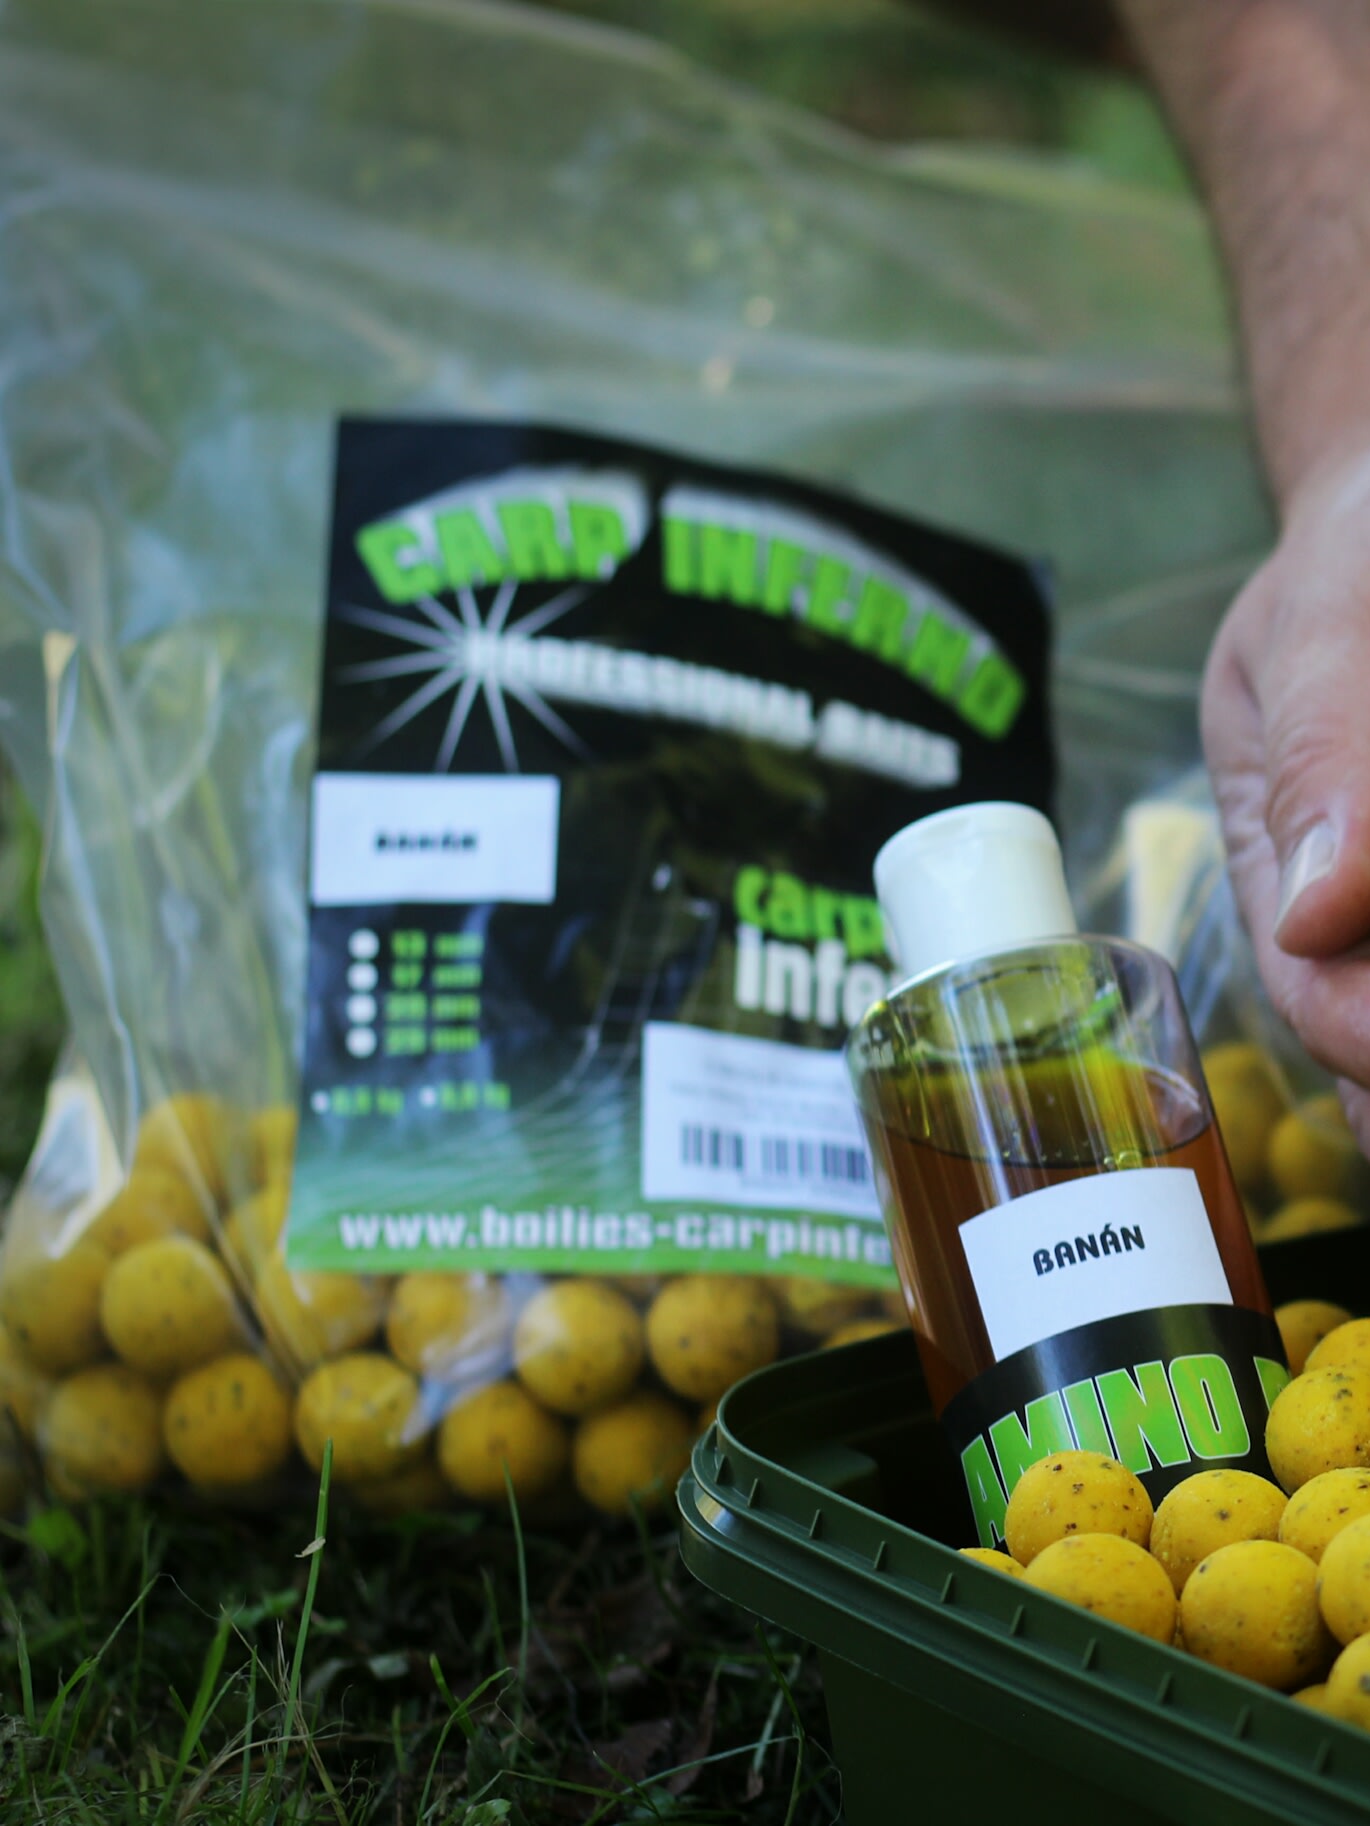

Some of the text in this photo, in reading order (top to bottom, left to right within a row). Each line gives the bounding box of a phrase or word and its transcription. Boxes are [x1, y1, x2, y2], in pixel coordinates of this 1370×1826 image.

[356, 484, 1026, 741] CARP INFERNO
[734, 922, 906, 1029] infe
[1032, 1222, 1147, 1275] BANÁN
[960, 1353, 1251, 1549] AMINO
